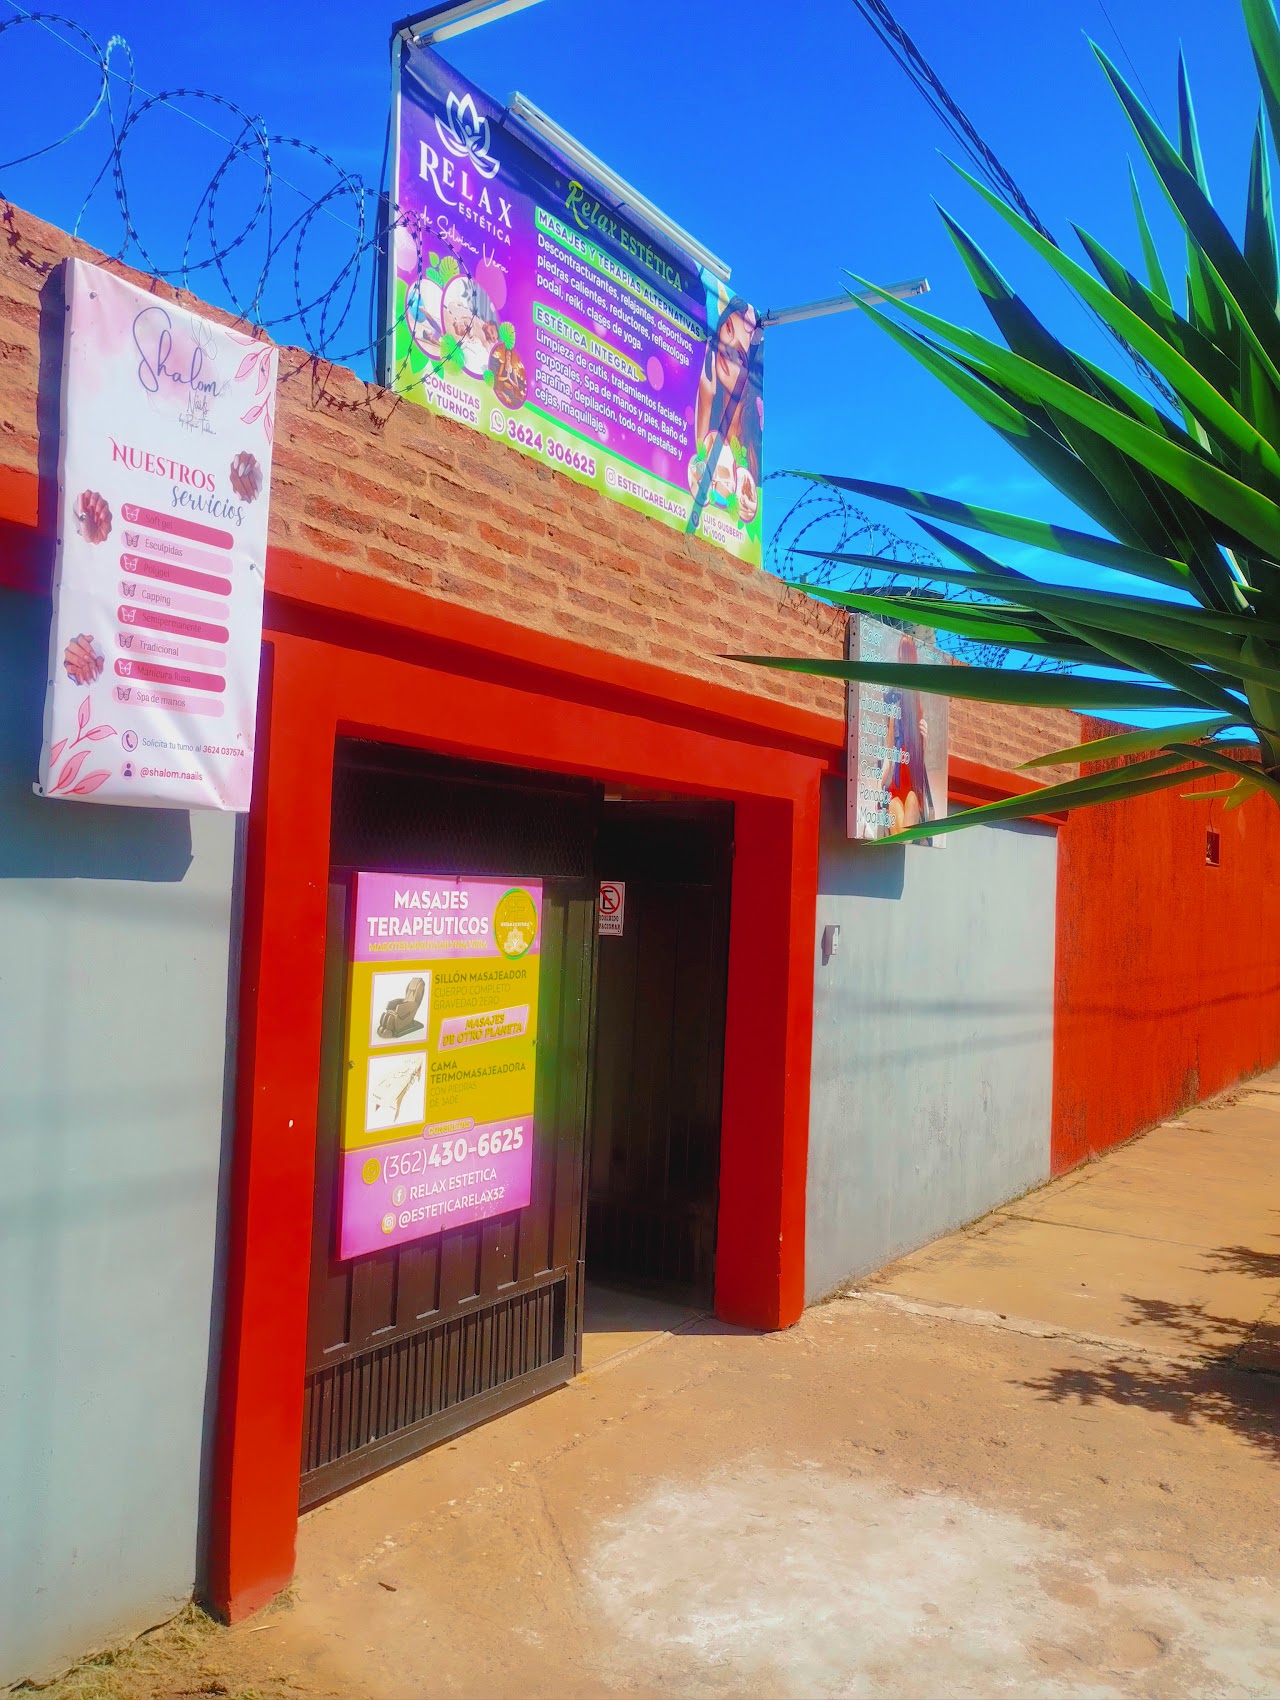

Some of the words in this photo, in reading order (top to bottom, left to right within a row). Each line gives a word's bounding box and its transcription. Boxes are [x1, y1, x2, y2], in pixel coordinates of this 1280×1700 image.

[419, 140, 512, 228] RELAX
[458, 202, 511, 246] ESTÉTICA
[565, 180, 617, 239] Relax
[620, 228, 683, 292] ESTÉTICA
[437, 215, 479, 254] Silvina
[483, 243, 508, 273] Vera
[538, 209, 587, 254] MASAJES
[587, 245, 597, 262] Y
[598, 251, 641, 295] TERAPIAS
[643, 288, 700, 338] ALTERNATIVAS
[537, 233, 620, 301] Descontracturantes,
[620, 293, 657, 327] relajantes,
[657, 320, 694, 354] deportivos,
[536, 273, 564, 301] podal,
[565, 293, 585, 315] reiki,
[586, 306, 611, 332] clases
[612, 322, 623, 337] de
[623, 330, 643, 352] yoga.
[537, 254, 569, 284] piedras
[570, 278, 608, 311] calientes,
[609, 304, 651, 341] reductores,
[651, 332, 690, 366] reflexología
[132, 306, 220, 397] Shalom
[536, 306, 588, 351] ESTÉTICA
[590, 339, 640, 382] INTEGRAL
[424, 374, 480, 410] CONSULTAS
[536, 327, 574, 361] Limpieza
[575, 353, 587, 369] de
[588, 362, 610, 382] cutis,
[611, 373, 657, 410] tratamientos
[657, 401, 683, 426] faciales
[682, 420, 688, 431] y
[426, 389, 435, 402] Y
[436, 394, 479, 424] TURNOS:
[535, 350, 583, 386] corporales,
[584, 375, 600, 396] Spa
[600, 386, 611, 400] de
[612, 394, 638, 416] manos
[637, 409, 643, 421] y
[643, 412, 660, 431] pies,
[661, 421, 679, 441] Baño
[679, 433, 688, 446] de
[535, 387, 560, 410] cejas,
[535, 368, 573, 398] parafina,
[574, 389, 618, 423] depilación,
[619, 412, 636, 433] todo
[637, 426, 647, 439] en
[647, 432, 678, 457] pestañas
[677, 449, 683, 461] y
[508, 419, 543, 452] 3624
[547, 438, 596, 477] 306625
[107, 436, 216, 492] NUESTROS
[171, 485, 246, 527] servicios
[617, 475, 687, 520] ESTETICARELAX32
[145, 514, 161, 526] Soft
[161, 519, 173, 530] gel
[145, 538, 183, 557] Esculpidas
[143, 563, 170, 578] Polygel
[141, 589, 171, 606] Capping
[142, 612, 202, 633] Semipermanente
[139, 640, 179, 656] Tradicional
[138, 665, 172, 680] Manicura
[136, 692, 150, 703] Spa
[150, 693, 160, 703] de
[160, 697, 186, 707] manos
[142, 737, 168, 748] Solicita
[169, 742, 176, 750] tu
[195, 744, 202, 753] al
[202, 745, 220, 754] 3624
[394, 889, 469, 910] MASAJES
[367, 912, 489, 937] TERAPÉUTICOS
[434, 986, 467, 998] CUERPO
[469, 983, 511, 995] COMPLETO
[435, 971, 467, 984] SILLÓN
[469, 969, 527, 982] MASAJEADOR
[433, 997, 477, 1010] GRAVEDAD
[479, 996, 499, 1006] ZERO
[442, 1033, 456, 1046] DE
[457, 1029, 482, 1044] OTRO
[485, 1022, 523, 1038] PLANETA
[465, 1013, 505, 1030] MASAJES
[430, 1062, 526, 1084] TERMOMASAJEADORA
[431, 1060, 457, 1072] CAMA
[430, 1086, 446, 1097] CON
[448, 1081, 477, 1093] PIEDRAS
[428, 1120, 471, 1136] CONSULTAS
[410, 1179, 446, 1200] RELAX
[449, 1167, 497, 1192] ESTETICA
[398, 1186, 505, 1228] @ESTETICARELAX32
